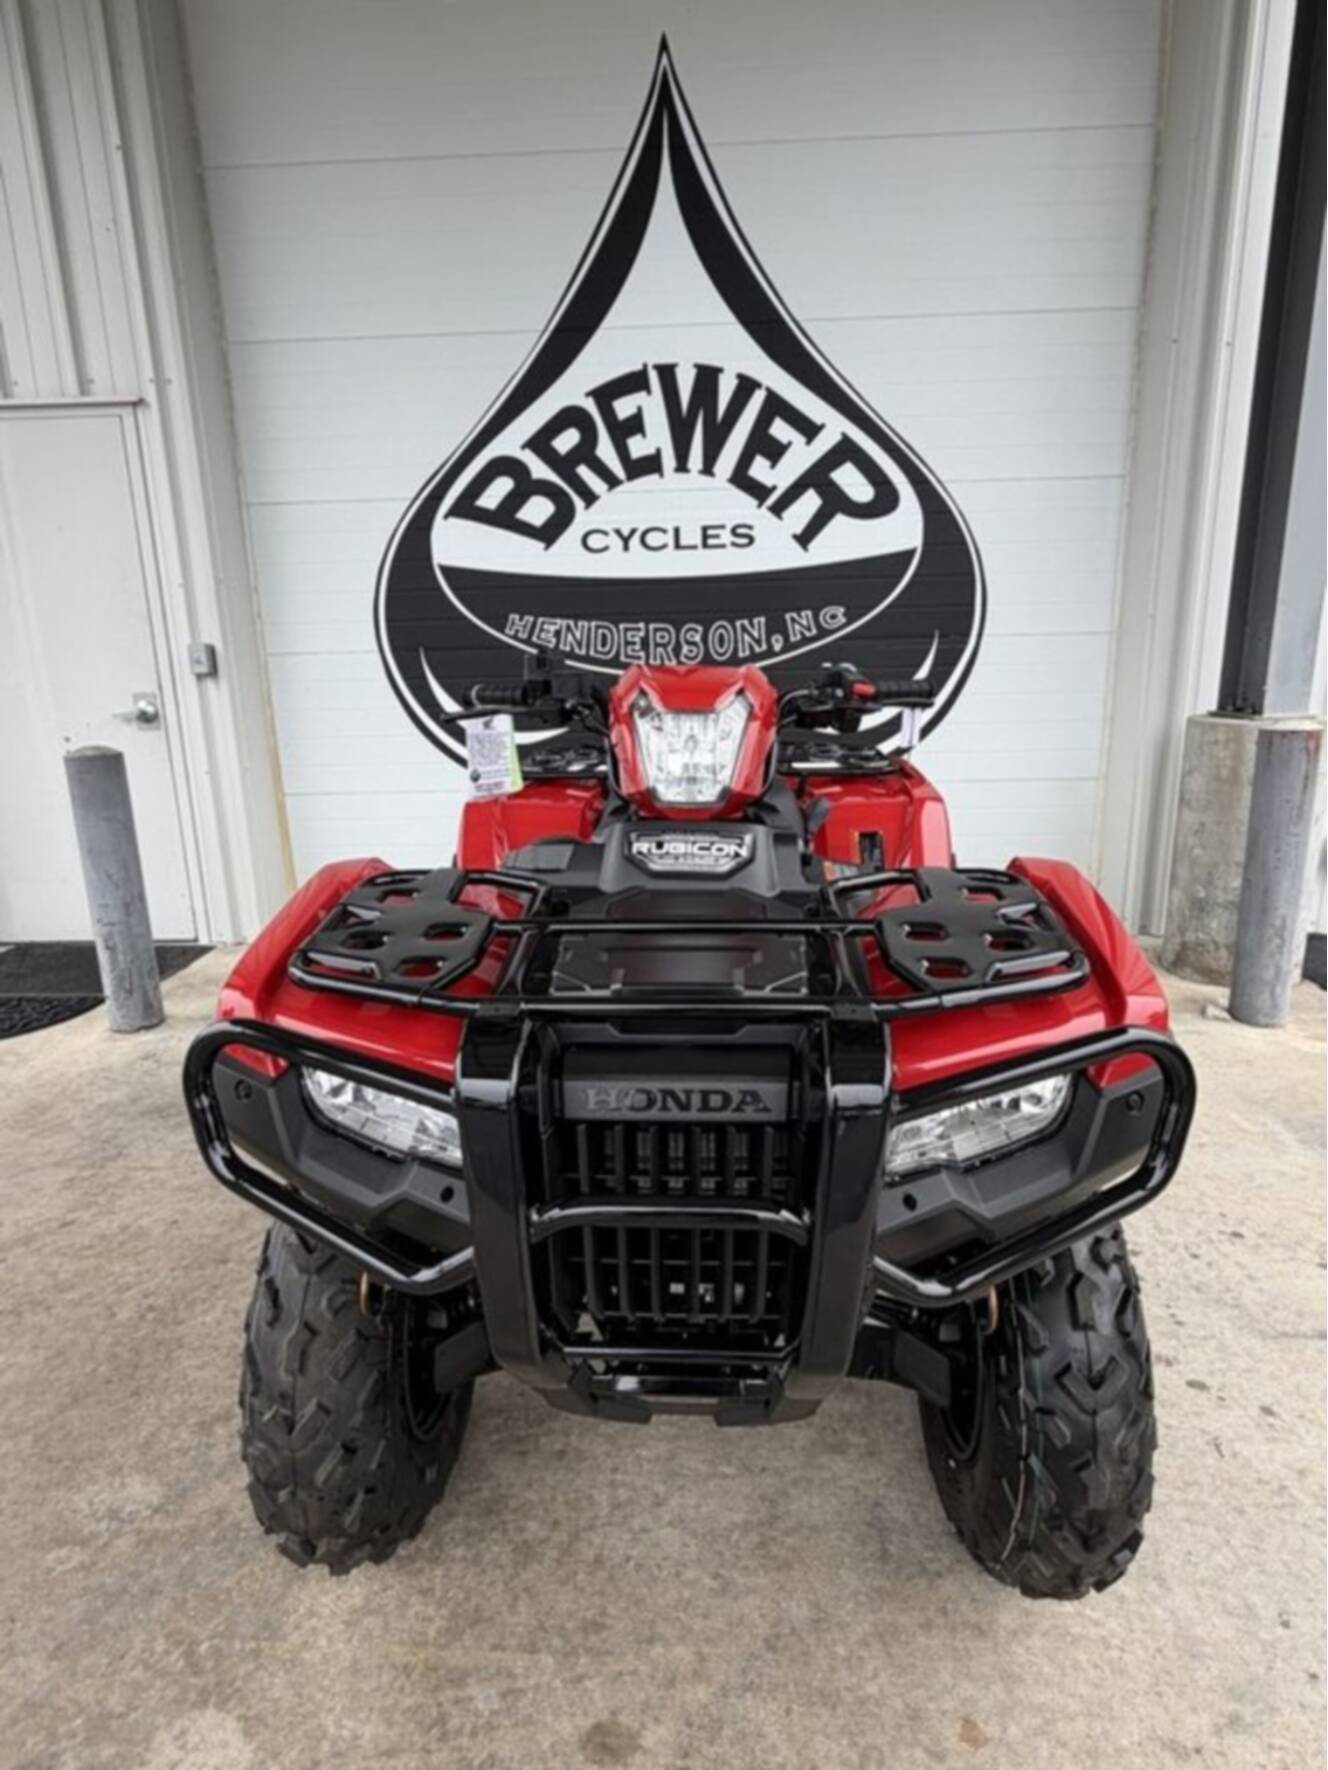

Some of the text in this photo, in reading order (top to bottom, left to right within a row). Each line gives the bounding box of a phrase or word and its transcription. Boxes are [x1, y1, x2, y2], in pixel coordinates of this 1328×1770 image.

[443, 362, 900, 552] BREWER
[581, 523, 755, 553] CYCLES
[632, 841, 748, 857] RUBICON
[587, 1088, 772, 1112] HONDA
